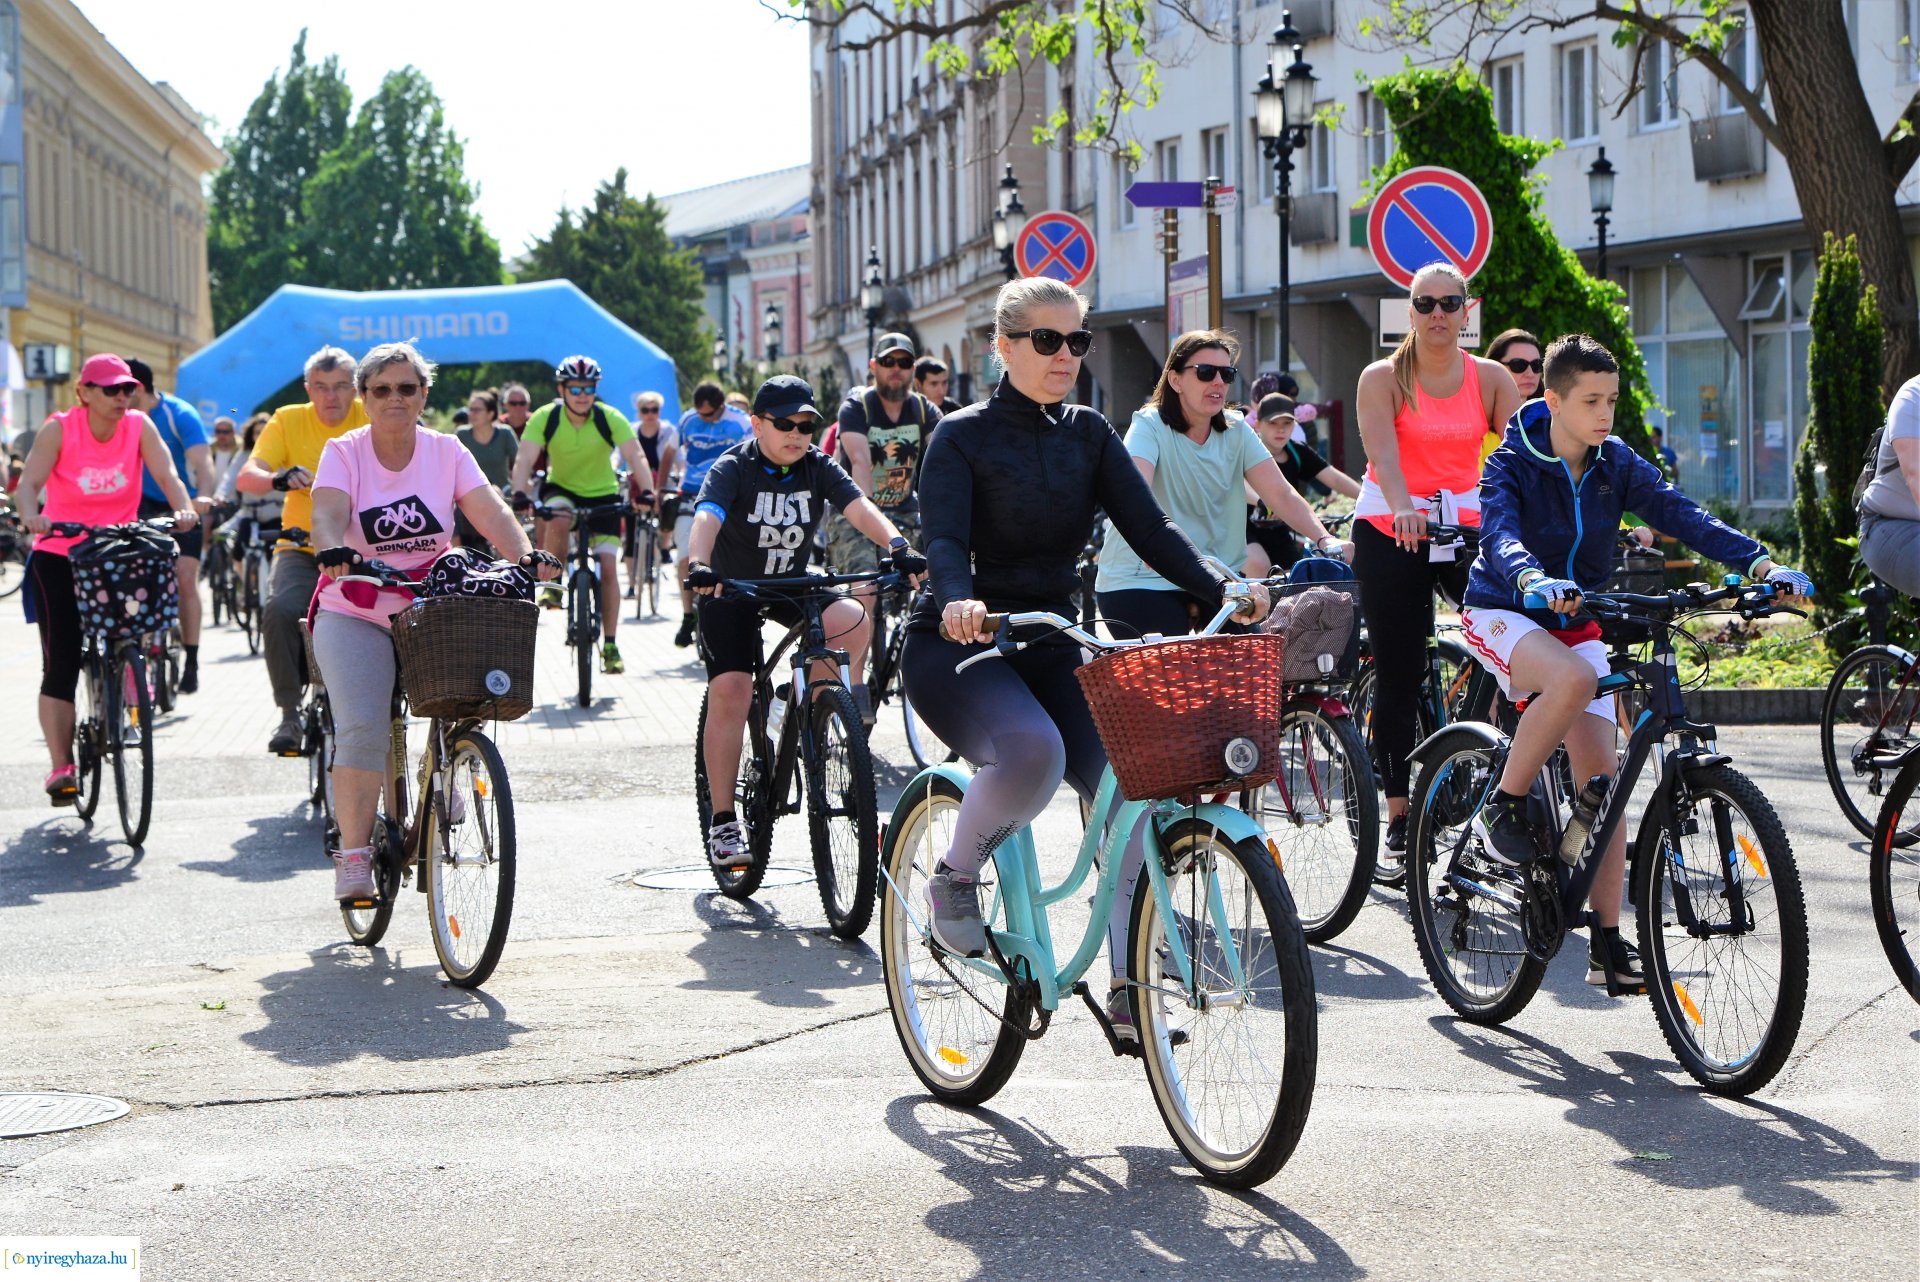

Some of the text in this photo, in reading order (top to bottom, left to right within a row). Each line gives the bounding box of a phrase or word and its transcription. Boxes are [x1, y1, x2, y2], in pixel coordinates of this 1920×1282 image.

[338, 311, 510, 341] SHIMANO
[747, 490, 811, 526] JUST
[758, 525, 804, 549] DO
[764, 548, 795, 574] IT.
[393, 723, 405, 773] Budapest
[1457, 880, 1498, 902] HEXAGON
